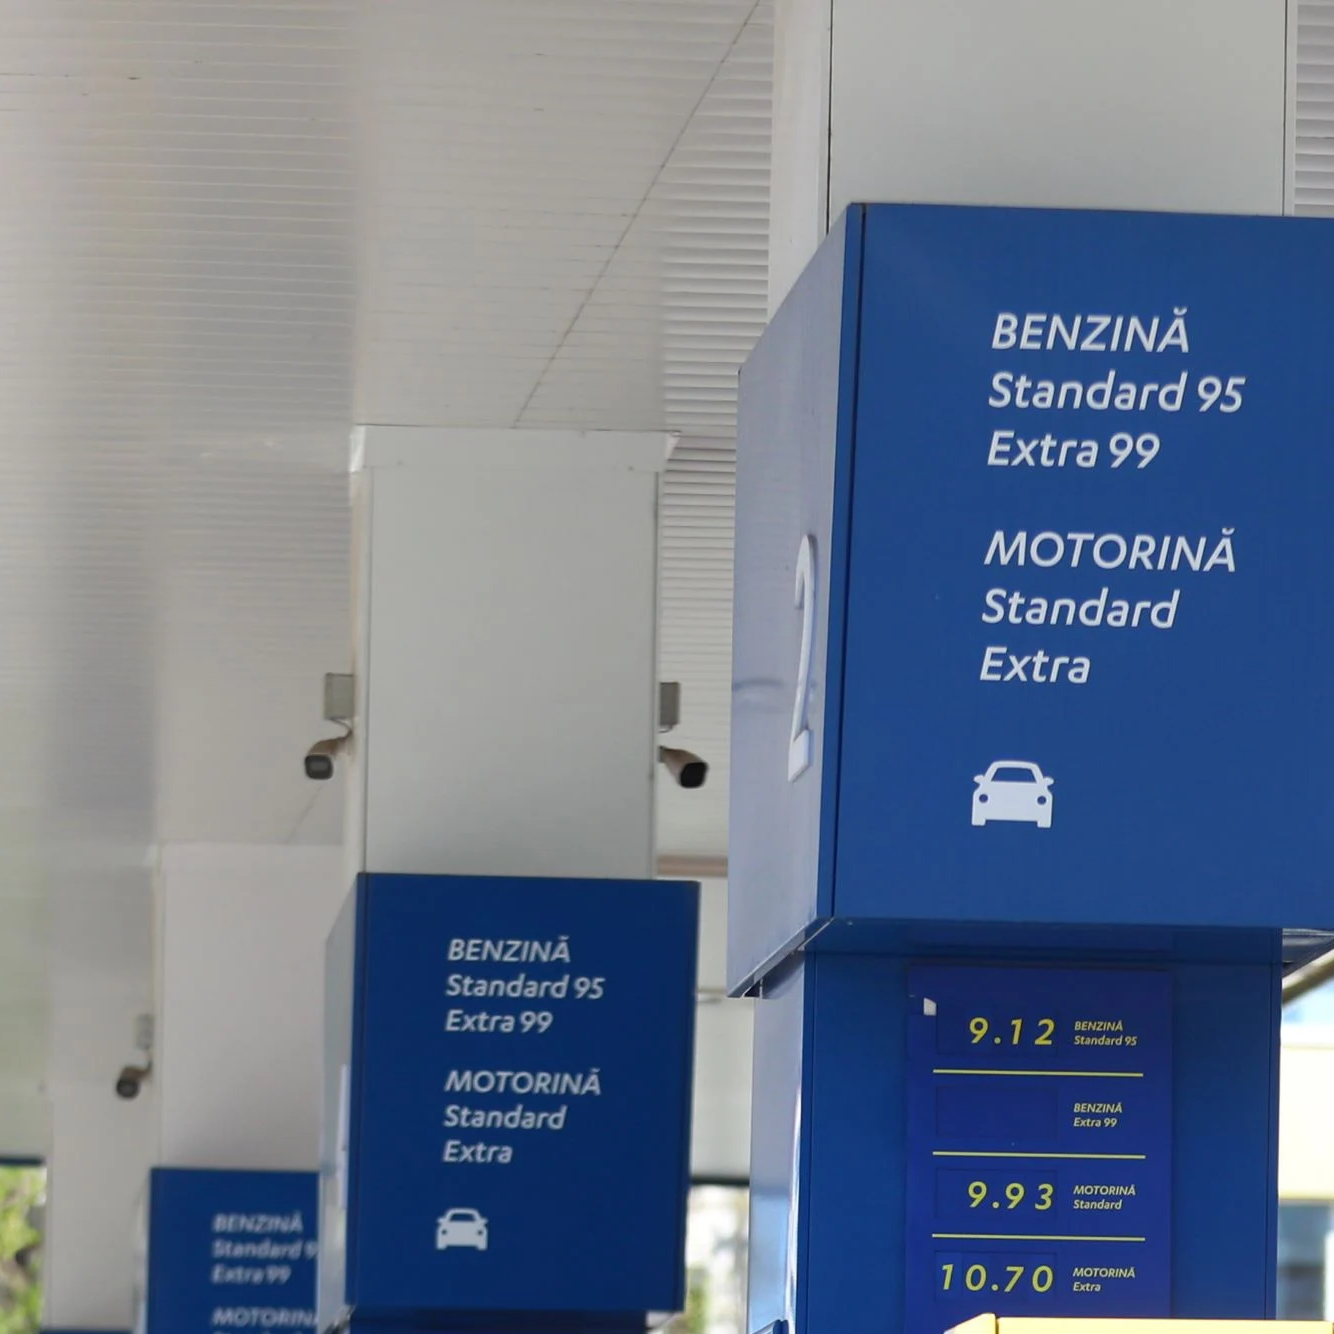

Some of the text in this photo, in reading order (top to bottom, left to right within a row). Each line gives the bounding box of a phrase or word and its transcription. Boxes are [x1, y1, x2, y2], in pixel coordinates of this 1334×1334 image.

[992, 307, 1188, 352] BENZINĂ
[989, 370, 1245, 412] Standard 95
[988, 431, 1160, 468] Extra 99
[984, 528, 1235, 572] MOTORINĂ
[982, 587, 1180, 628] Standard
[786, 533, 816, 782] 2
[980, 647, 1090, 683] Extra
[448, 936, 570, 962] BENZINĂ
[446, 974, 605, 999] Standard 95
[445, 1009, 553, 1032] Extra 99
[970, 1018, 1054, 1045] 9.12
[1075, 1035, 1137, 1046] Standard 95
[445, 1068, 600, 1095] MOTORINĂ
[444, 1104, 567, 1129] Standard
[1074, 1117, 1117, 1127] Extra 99
[443, 1140, 512, 1163] Extra
[969, 1182, 1053, 1210] 9.93
[1074, 1199, 1122, 1209] Standard
[213, 1211, 303, 1233] BENZINĂ
[213, 1239, 303, 1259] Standard
[212, 1264, 292, 1284] Extra 99
[943, 1264, 1053, 1292] 10.70
[1073, 1282, 1101, 1291] Extra
[213, 1306, 319, 1328] MOTORIN
